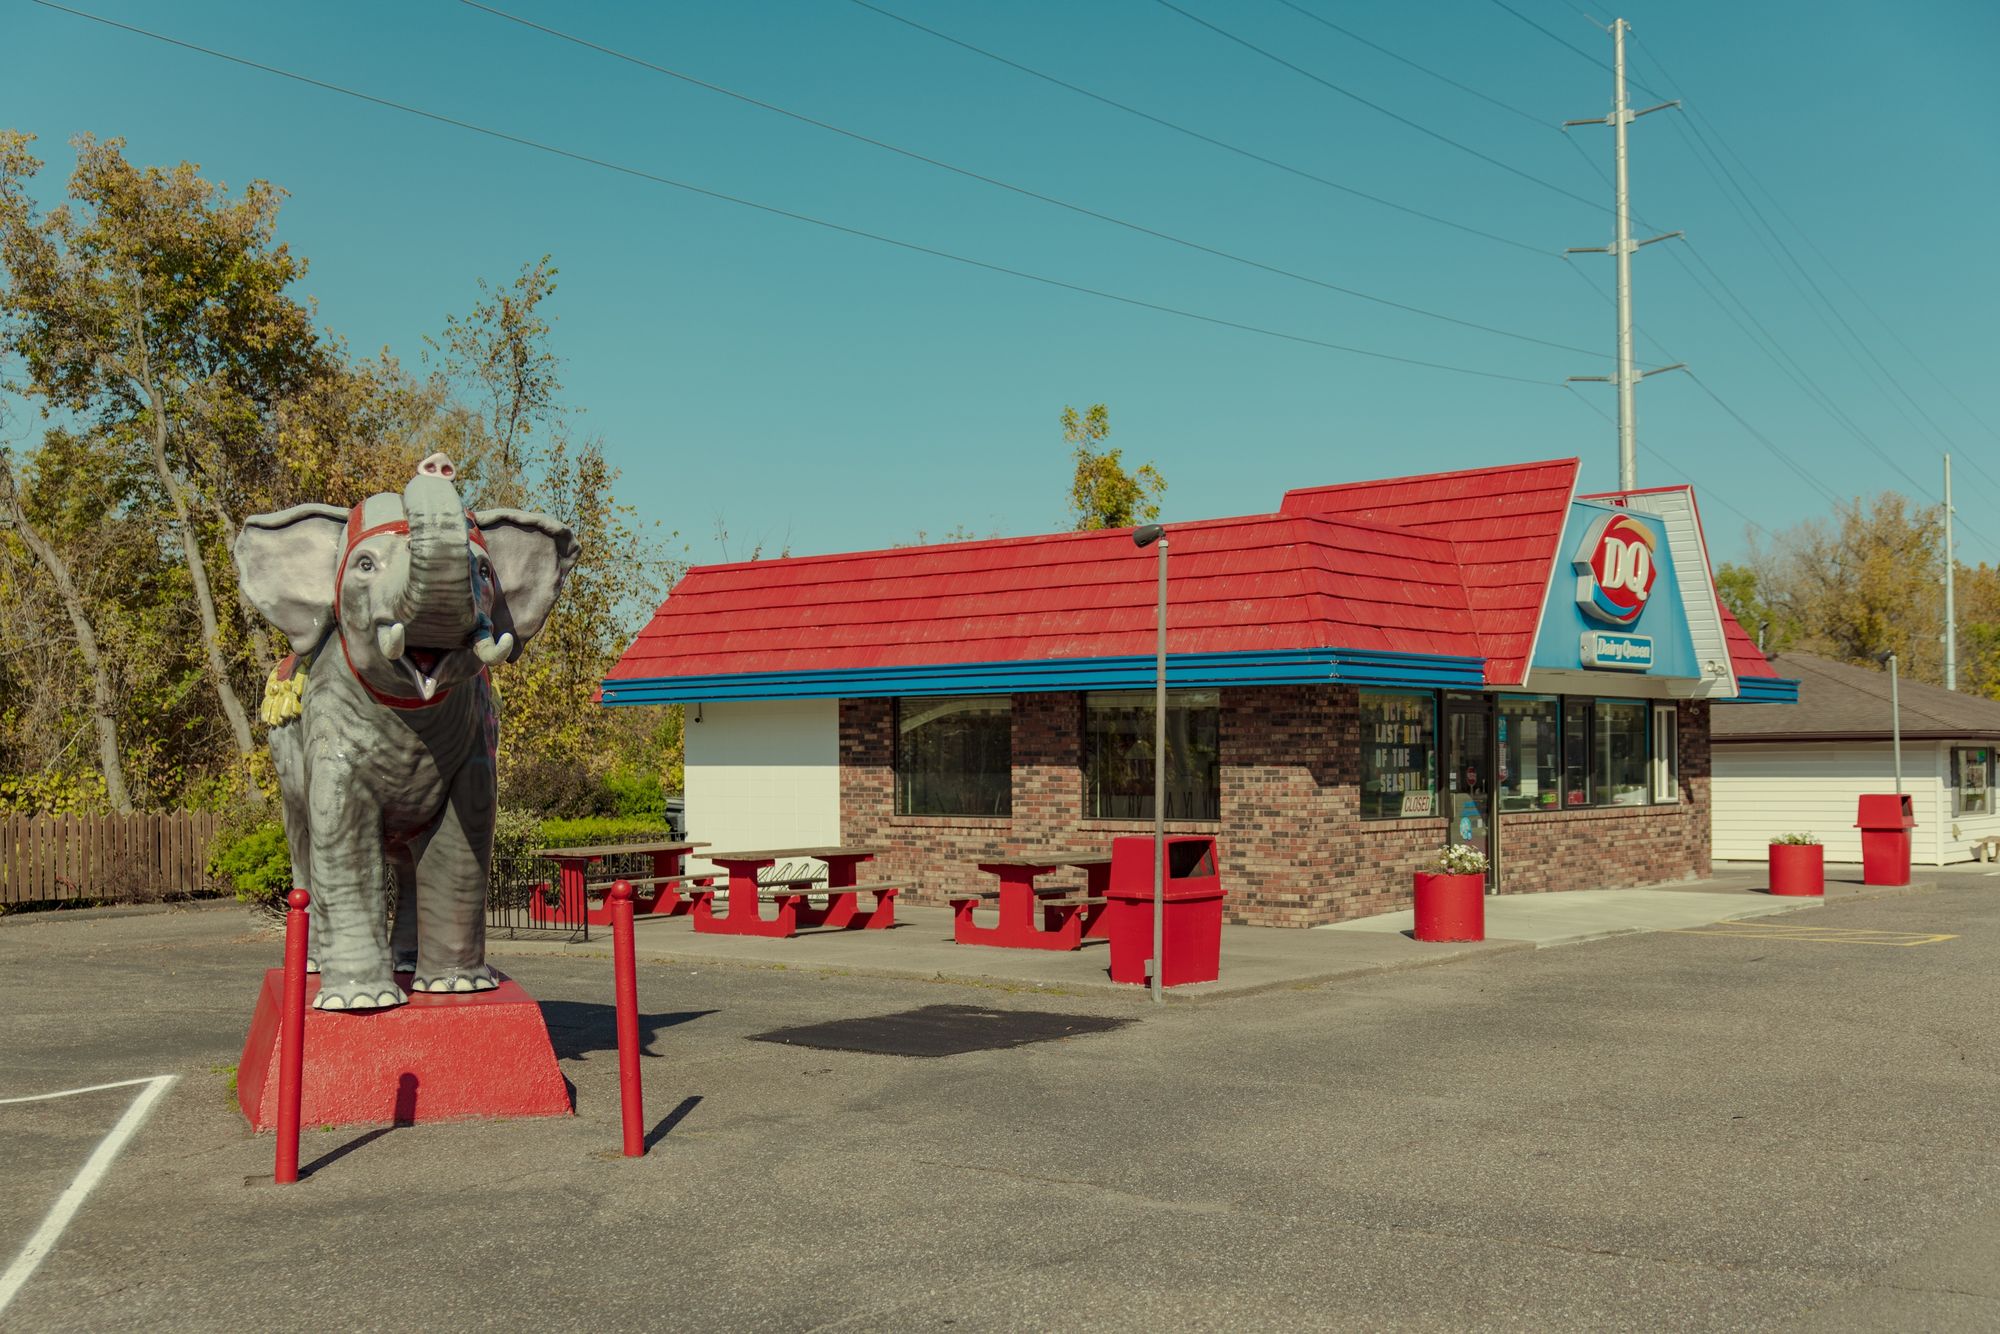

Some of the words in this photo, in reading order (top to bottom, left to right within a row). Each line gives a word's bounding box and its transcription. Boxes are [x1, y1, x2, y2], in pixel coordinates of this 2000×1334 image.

[1602, 537, 1649, 601] DQ
[1597, 638, 1622, 660] Dairy
[1622, 640, 1650, 659] Queen
[1383, 702, 1401, 721] OCT
[1375, 723, 1399, 743] LAST
[1403, 725, 1422, 744] DAY
[1375, 748, 1387, 767] OF
[1392, 748, 1410, 767] THE
[1380, 771, 1420, 792] SEASON!
[1404, 796, 1430, 812] CLOSED
